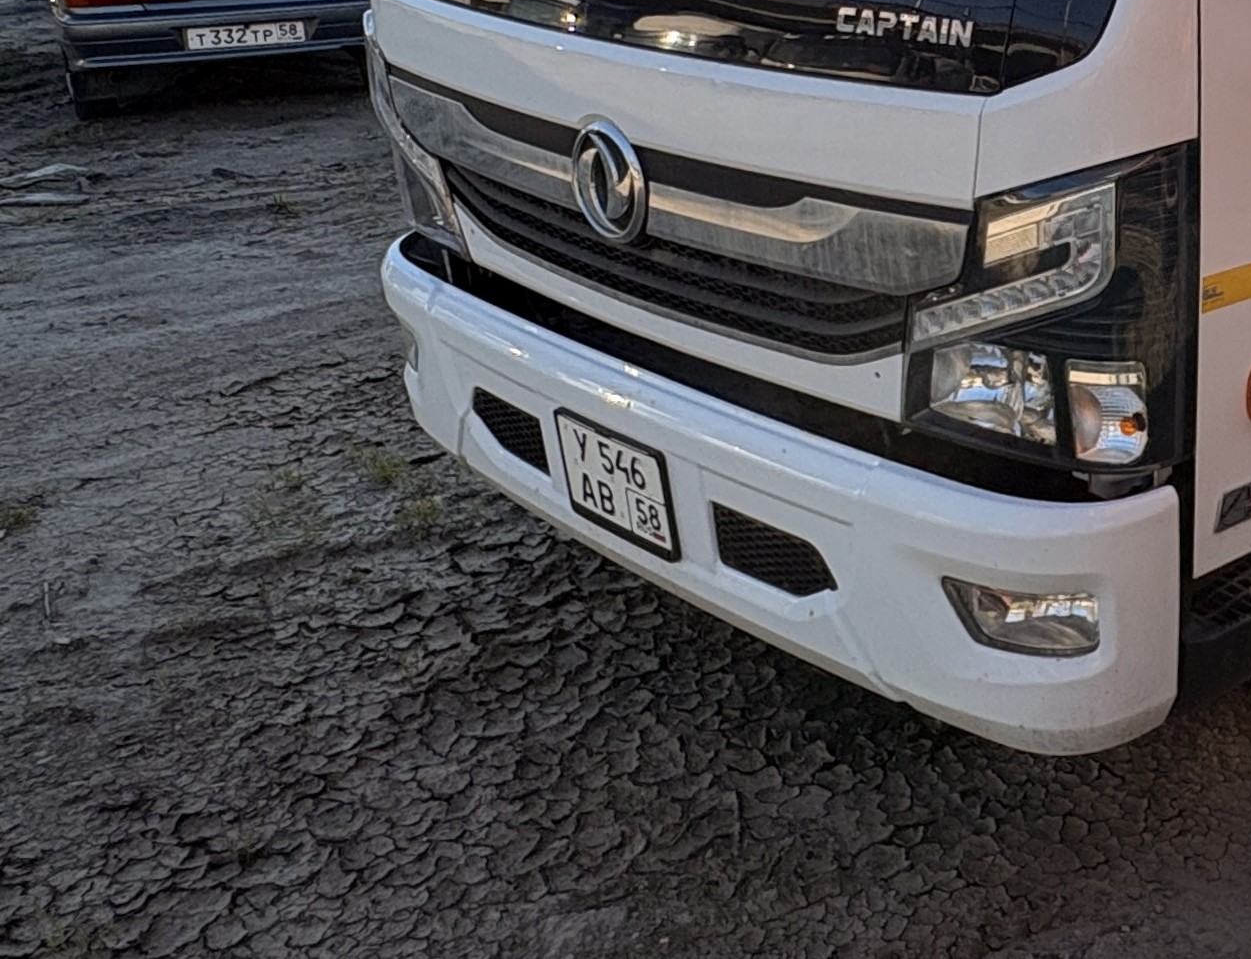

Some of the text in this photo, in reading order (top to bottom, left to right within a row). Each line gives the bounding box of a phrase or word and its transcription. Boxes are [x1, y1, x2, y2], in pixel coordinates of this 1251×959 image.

[278, 24, 298, 37] 58
[836, 7, 974, 48] CAPTAIN
[635, 497, 661, 531] 58
